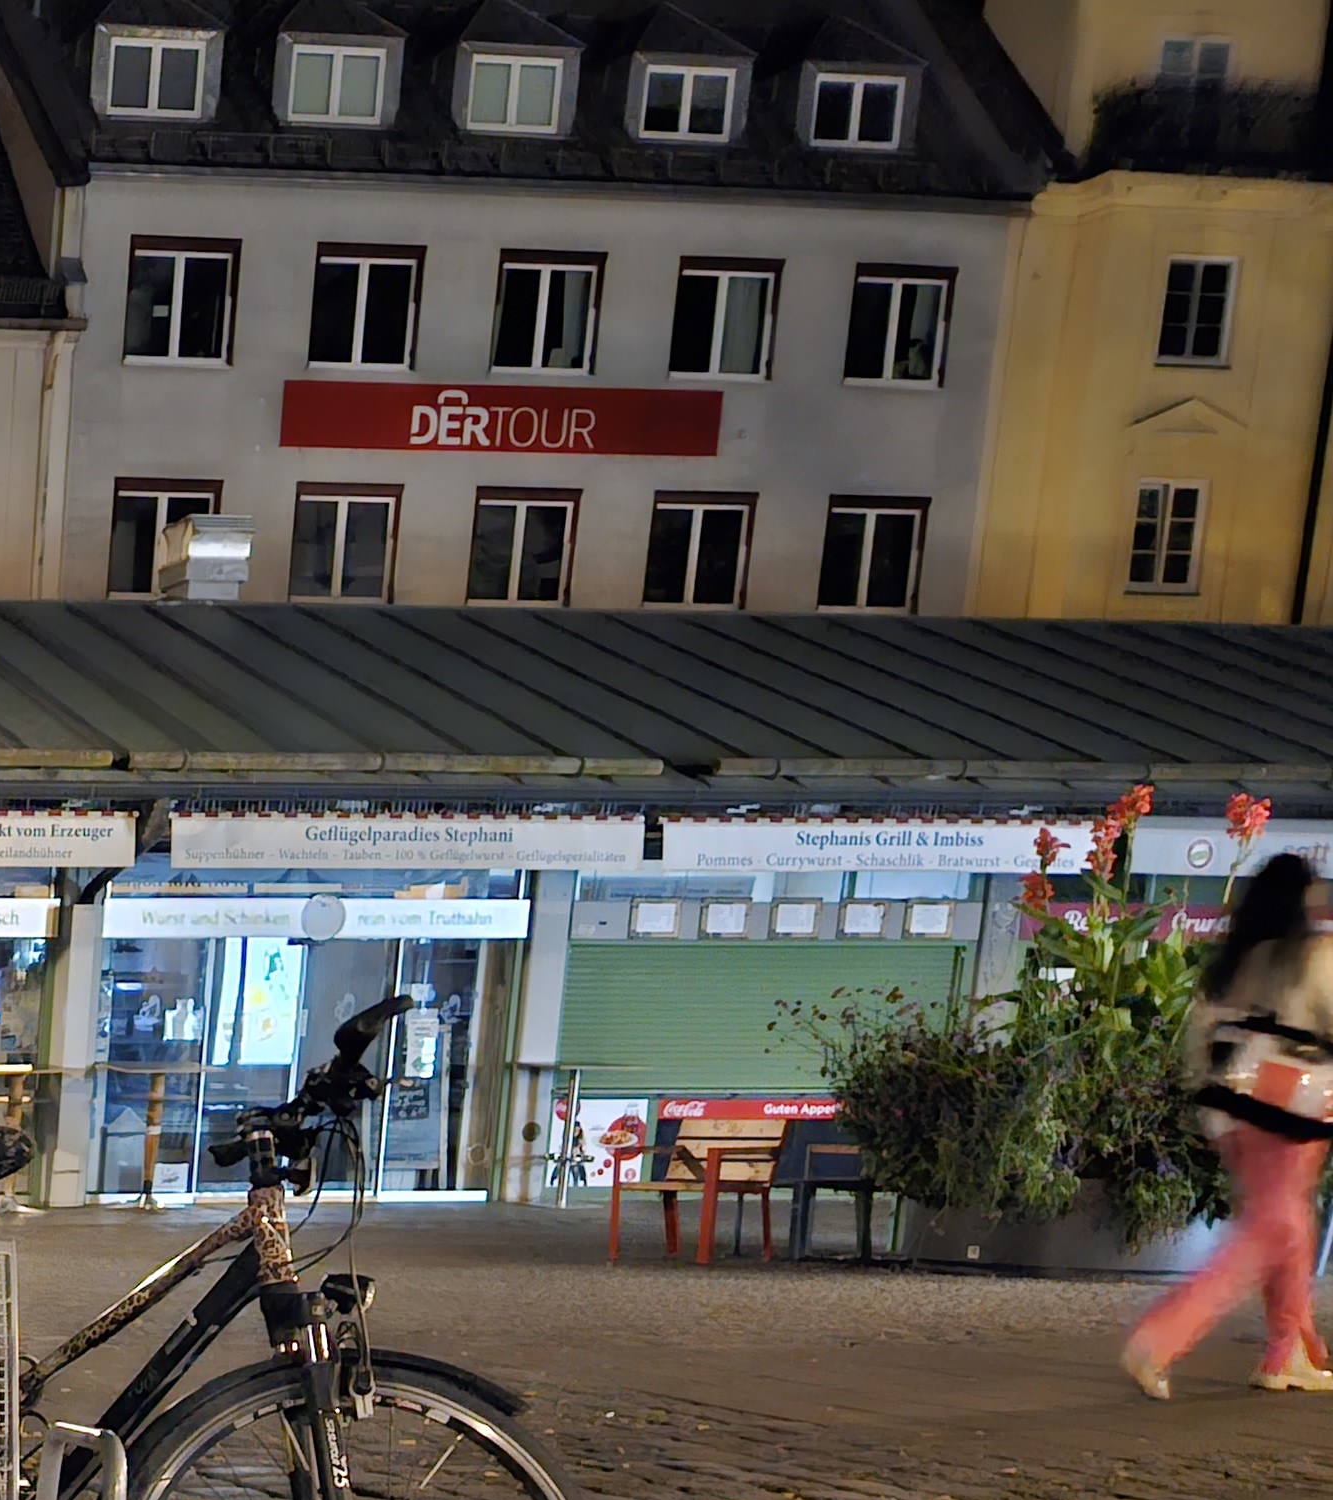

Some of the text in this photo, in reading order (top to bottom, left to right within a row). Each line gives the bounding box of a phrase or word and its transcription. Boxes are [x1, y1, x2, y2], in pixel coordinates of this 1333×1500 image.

[409, 400, 596, 449] DERTOUR
[16, 828, 46, 838] vom
[50, 824, 114, 842] Erzeuger
[305, 825, 513, 846] Geflügelparadies Stephani
[796, 830, 984, 850] Stephanis Grill & Imbiss
[278, 848, 328, 860] Wachteln
[343, 849, 382, 860] Tauben
[697, 853, 753, 867] Pommes
[766, 852, 842, 870] Currywurst
[855, 853, 924, 867] Schaschlik
[938, 854, 1000, 867] Bratwurst
[764, 1102, 798, 1115] Guten
